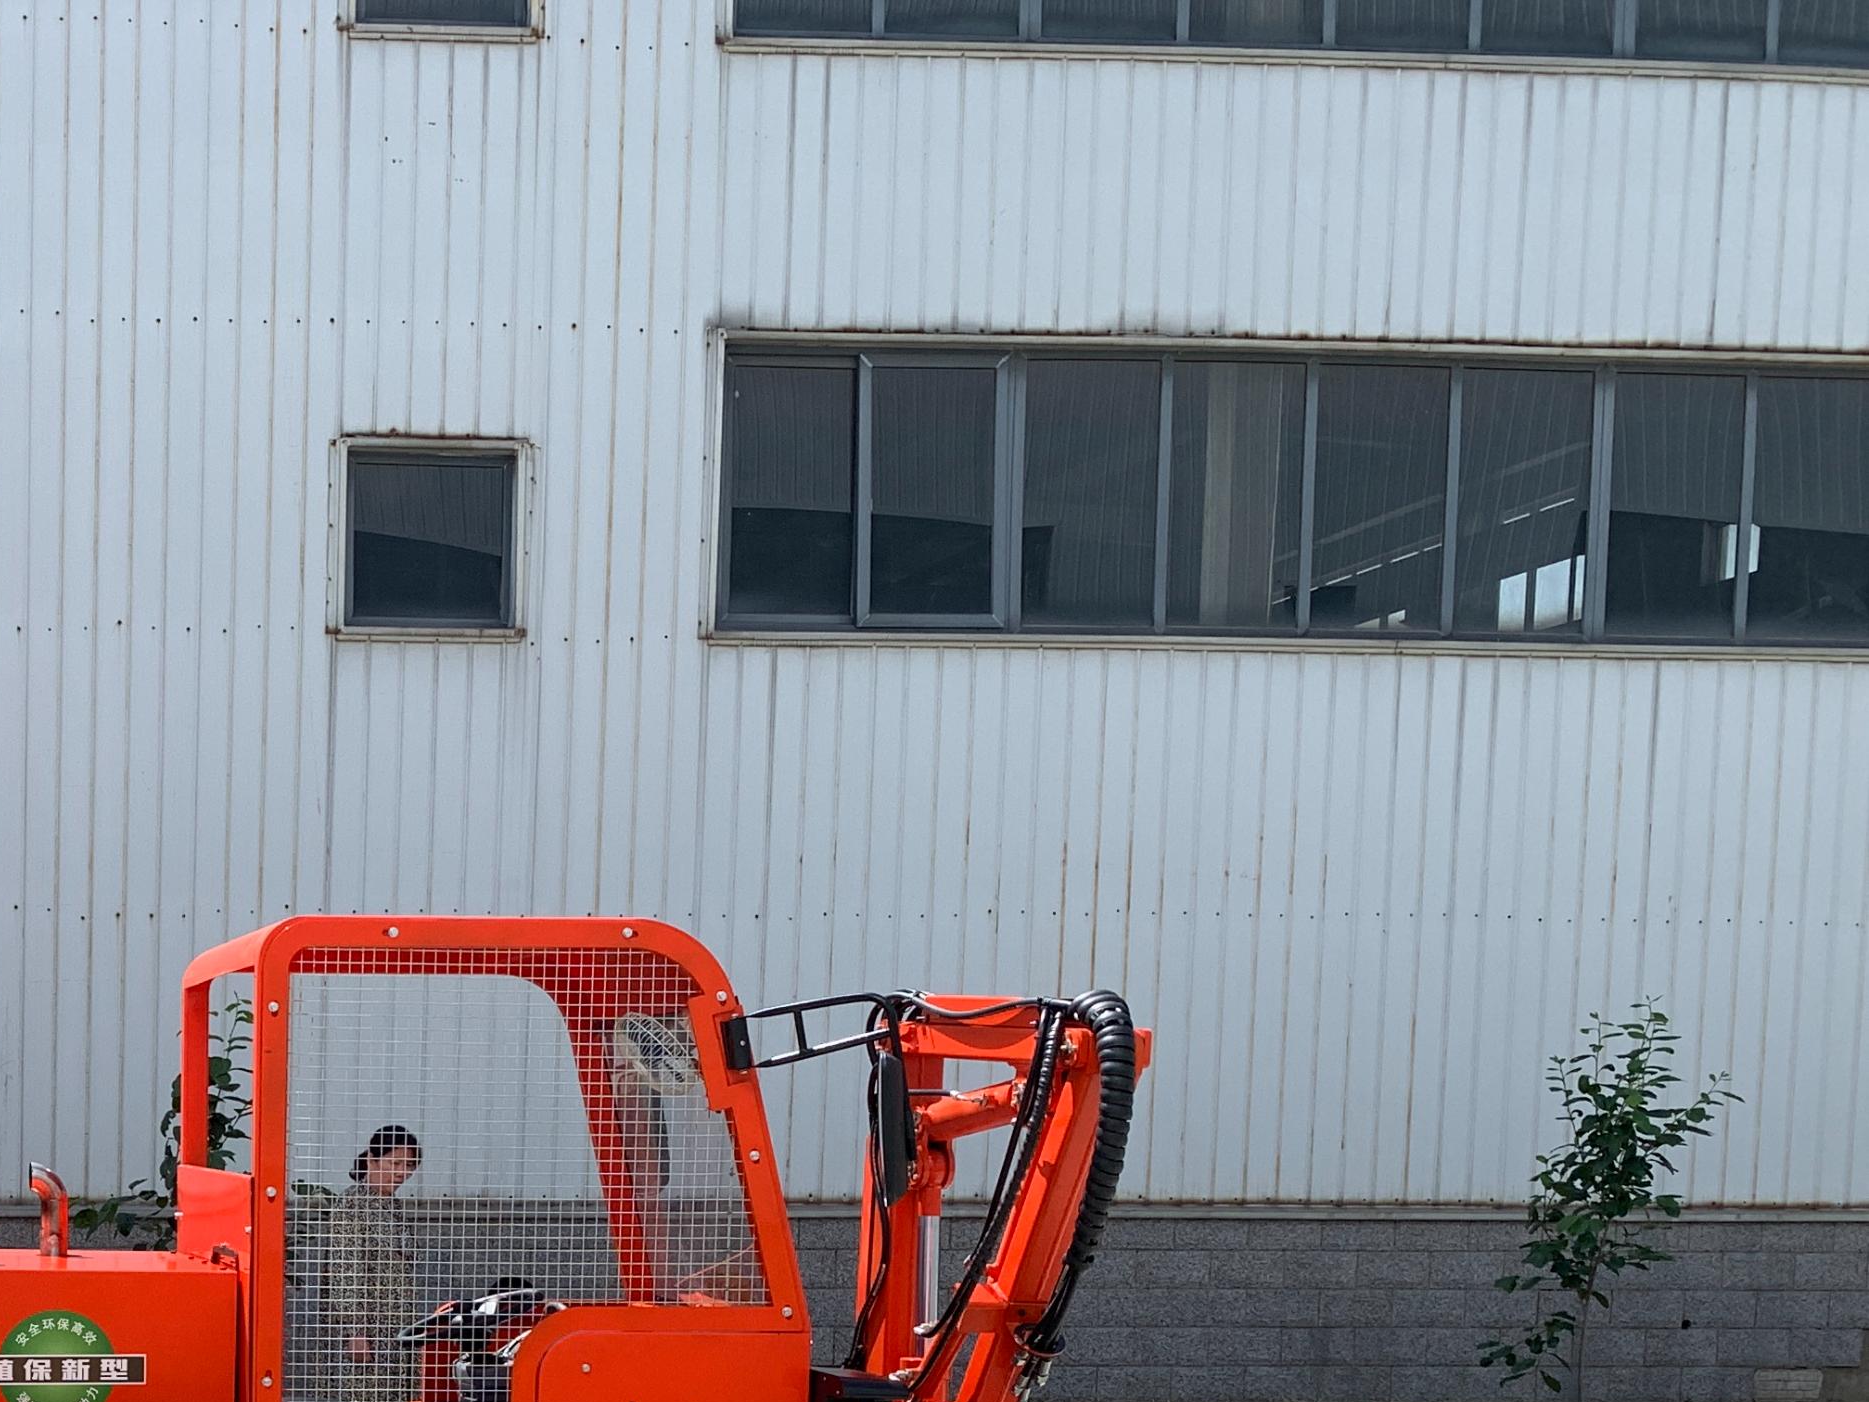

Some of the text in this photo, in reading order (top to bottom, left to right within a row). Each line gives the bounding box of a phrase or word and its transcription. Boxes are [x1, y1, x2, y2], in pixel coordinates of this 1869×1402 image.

[15, 1318, 98, 1347] 安全环保高效
